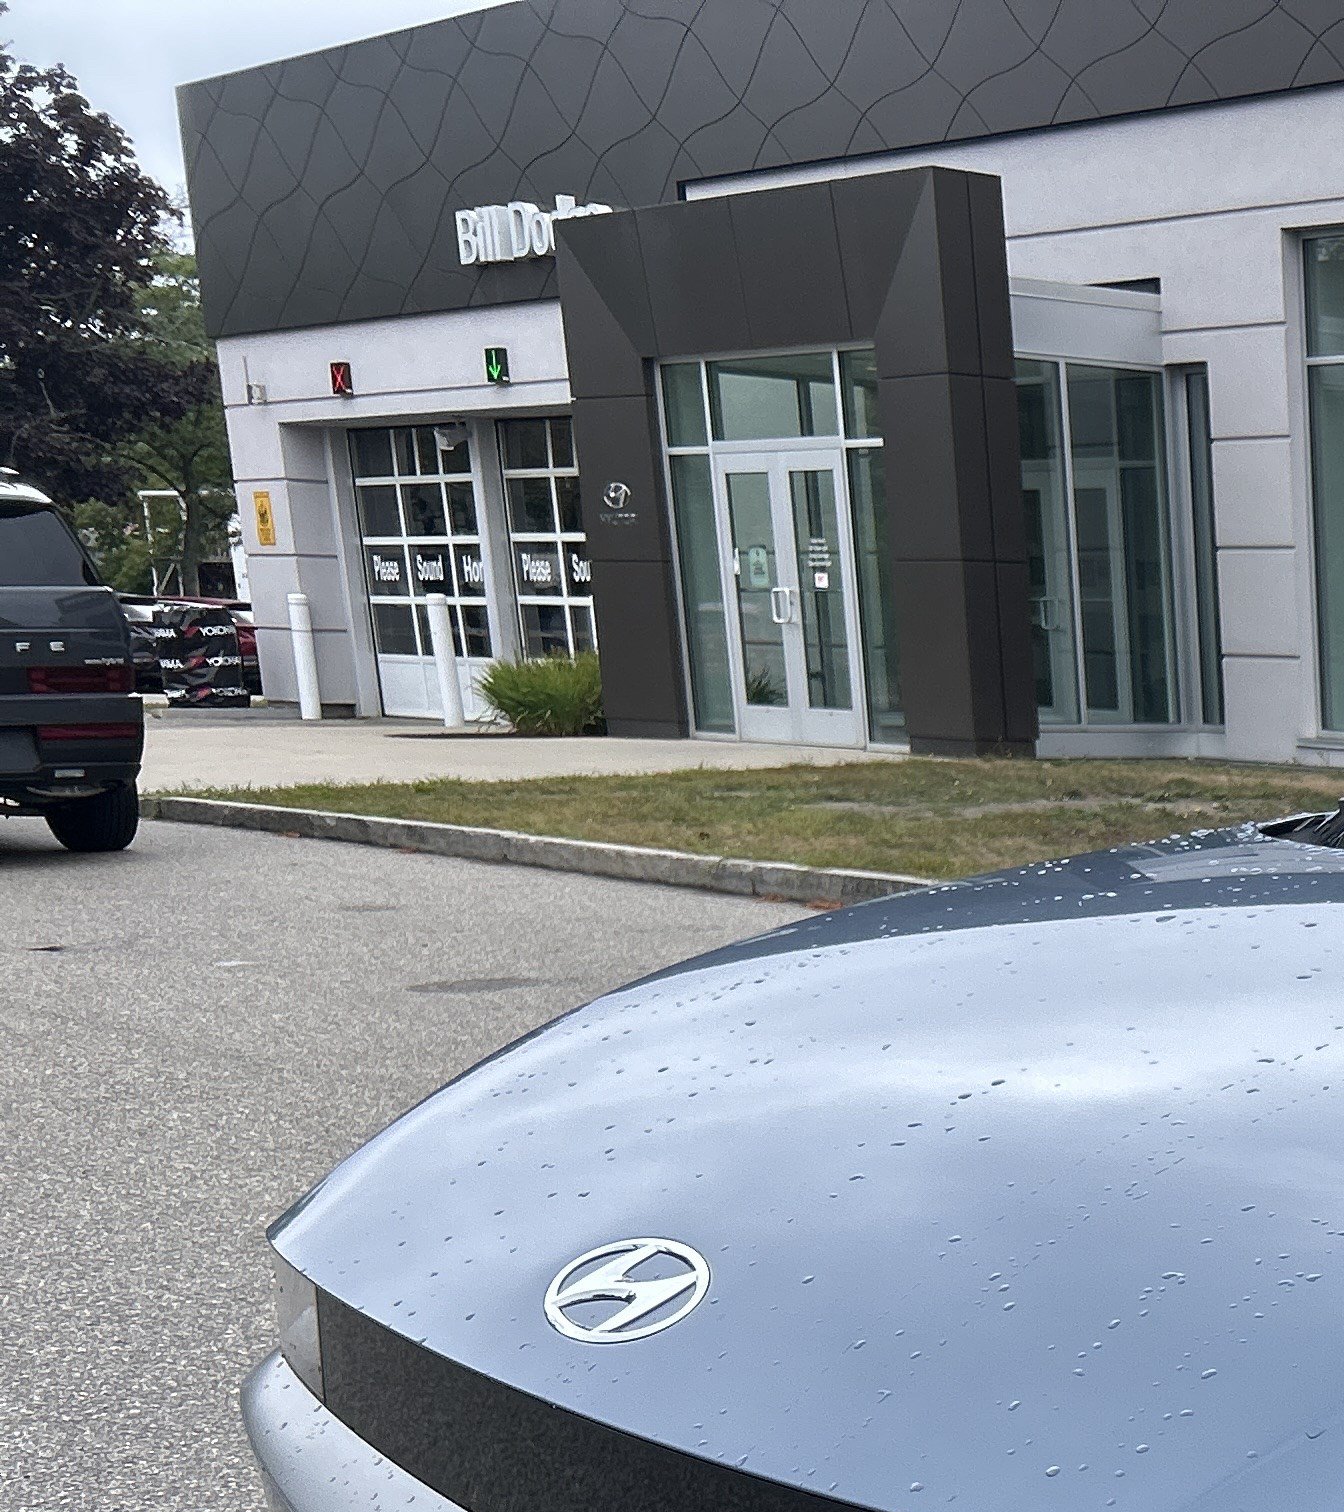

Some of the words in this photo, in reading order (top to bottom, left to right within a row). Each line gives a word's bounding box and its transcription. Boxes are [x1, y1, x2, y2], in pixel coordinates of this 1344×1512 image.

[455, 203, 514, 265] Bill
[372, 555, 401, 583] Please
[416, 554, 444, 582] Sound
[462, 555, 485, 583] Ho
[521, 553, 552, 582] Please
[572, 553, 592, 582] Sou
